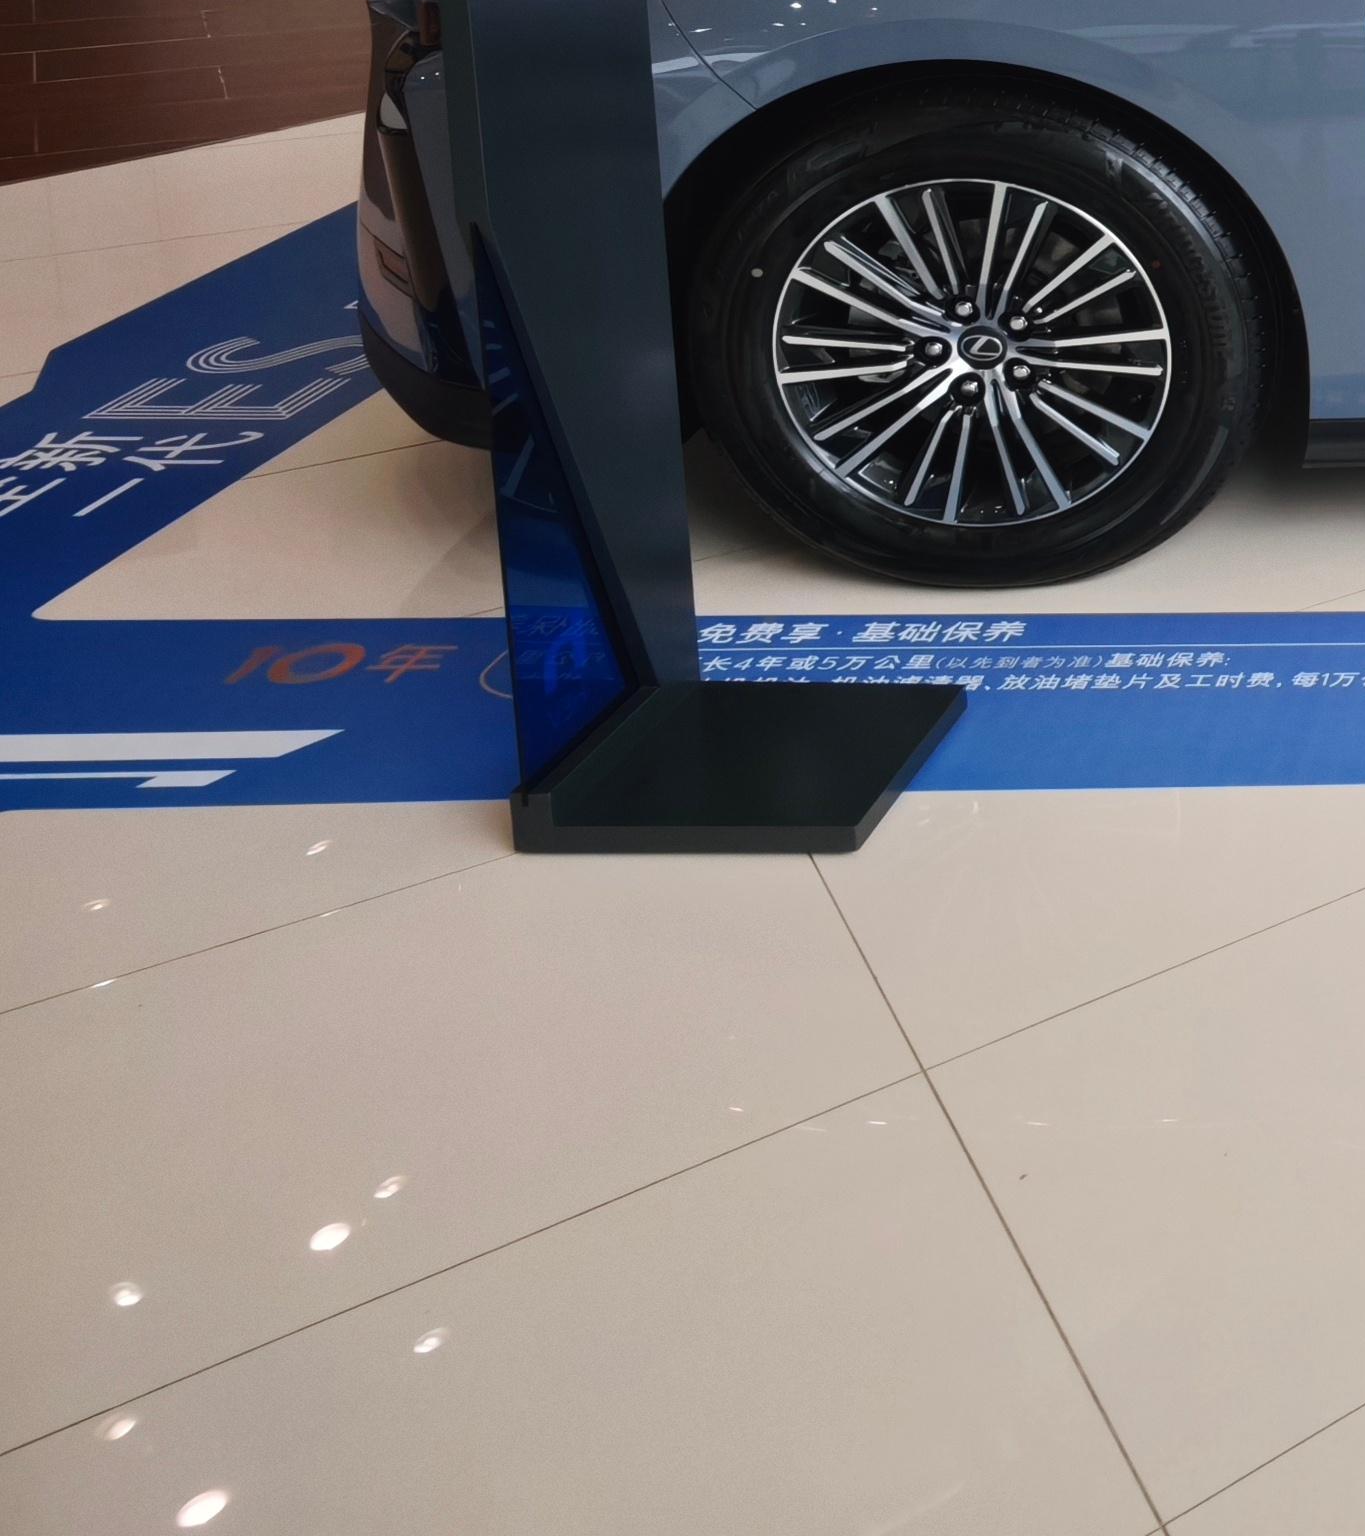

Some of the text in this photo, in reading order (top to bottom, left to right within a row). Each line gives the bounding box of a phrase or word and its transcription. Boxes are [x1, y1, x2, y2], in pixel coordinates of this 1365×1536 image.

[225, 643, 458, 685] 10年
[698, 650, 1231, 672] 长4年或5万公里(以先到者为准)基础保养:
